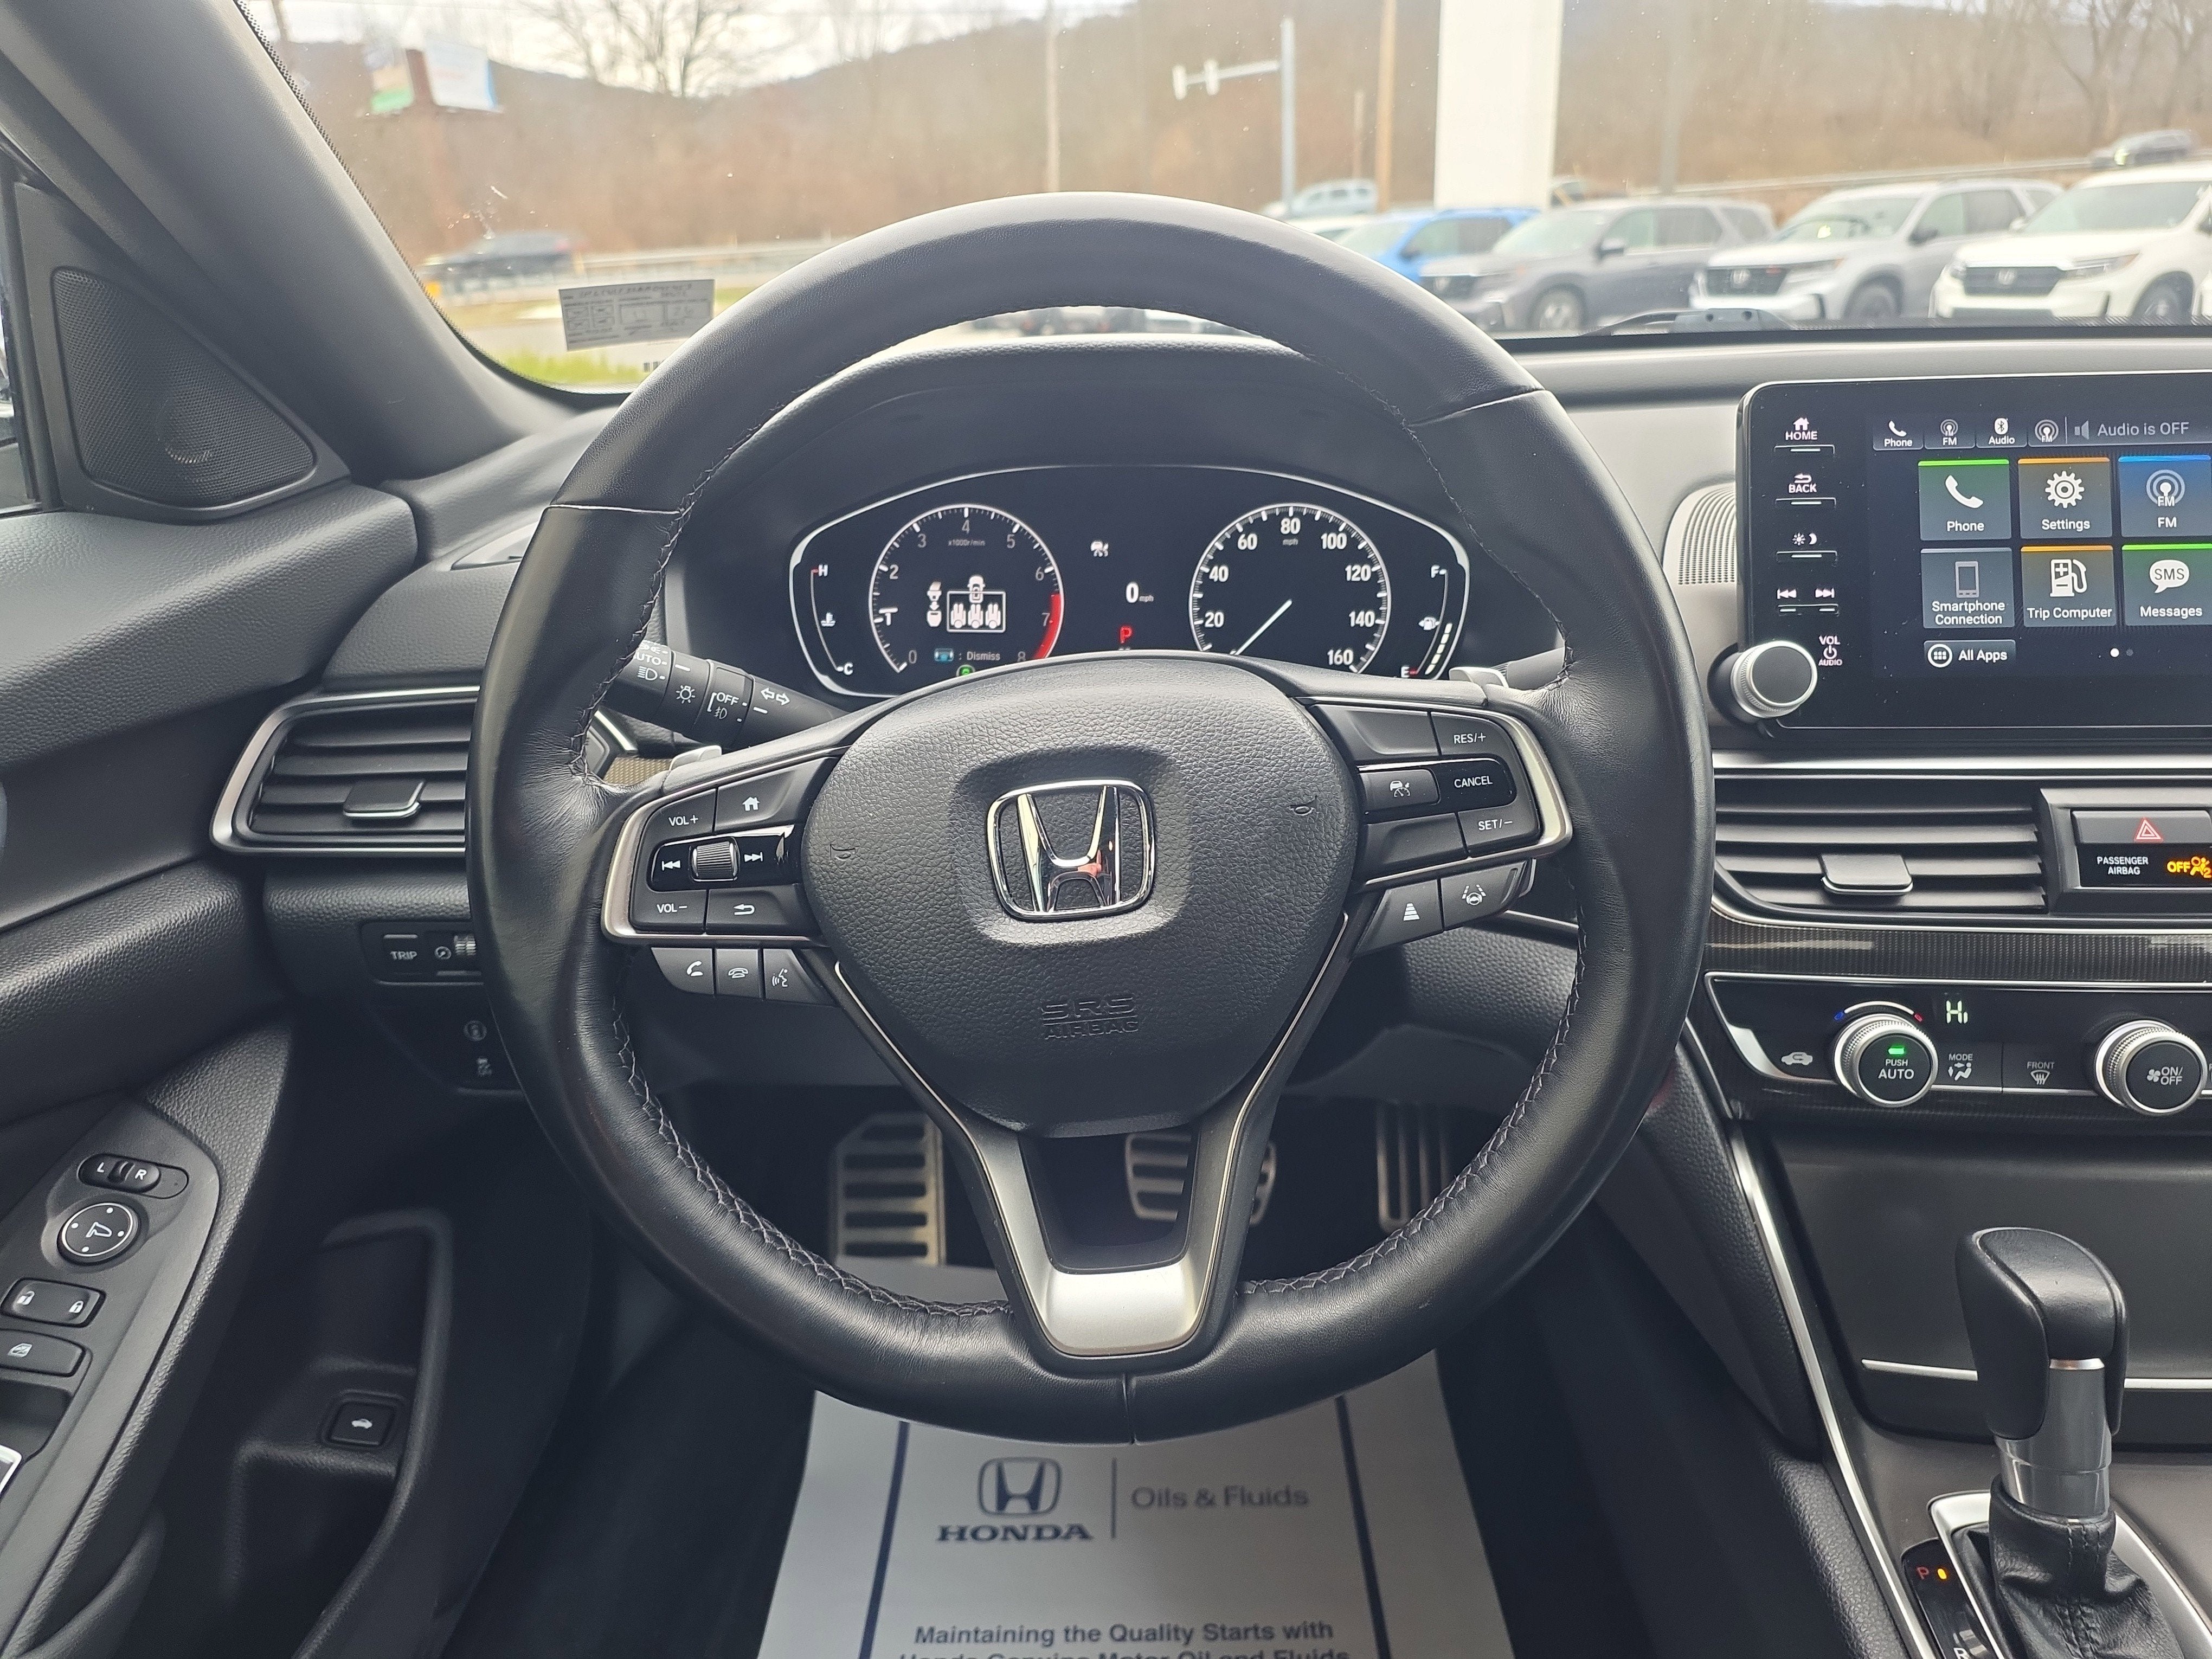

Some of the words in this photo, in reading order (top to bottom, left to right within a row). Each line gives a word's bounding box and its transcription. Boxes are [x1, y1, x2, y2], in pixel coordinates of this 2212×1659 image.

[2098, 423, 2139, 436] Audio
[2144, 424, 2155, 435] is
[2160, 422, 2189, 435] OFF
[1785, 431, 1817, 441] HOME
[1943, 437, 1957, 446] FM
[1989, 436, 2015, 445] Audio
[1884, 438, 1912, 448] Phone
[1789, 483, 1817, 493] BACK
[2158, 497, 2175, 507] FM
[962, 520, 970, 534] 4
[1281, 518, 1300, 535] 80
[1947, 520, 1984, 532] Phone
[2042, 519, 2091, 532] Settings
[2158, 517, 2177, 528] FM
[918, 533, 926, 548] 3
[1007, 534, 1015, 548] 5
[1238, 534, 1258, 550] 60
[1321, 533, 1347, 550] 100
[818, 565, 828, 576] H
[890, 565, 899, 580] 2
[1036, 567, 1044, 581] 6
[1209, 566, 1229, 582] 40
[1346, 565, 1371, 581] 120
[1431, 566, 1440, 577] F
[2154, 568, 2185, 581] SMS
[1126, 582, 1139, 603] 0
[1932, 601, 2005, 613] Smartphone
[2027, 608, 2050, 619] Trip
[2054, 607, 2112, 619] Computer
[2140, 606, 2203, 619] Messages
[1041, 613, 1050, 627] 7
[1205, 612, 1225, 627] 20
[1349, 611, 1375, 627] 140
[1935, 614, 2002, 625] Connection
[1120, 626, 1133, 644] P
[1819, 635, 1840, 645] VOL
[909, 650, 917, 664] 0
[967, 652, 1000, 661] Dismiss
[1328, 650, 1354, 666] 160
[1818, 658, 1843, 666] AUDIO
[1958, 650, 1975, 661] All
[1977, 650, 2008, 664] Apps
[844, 663, 853, 675] C
[1401, 666, 1410, 678] E
[716, 692, 739, 706] OFF
[1454, 732, 1486, 744] RES/+
[1454, 776, 1493, 788] CANCEL
[2097, 856, 2149, 865] PASSENGER
[2108, 866, 2140, 875] AIRBAG
[2166, 861, 2191, 873] OFF
[390, 951, 417, 960] TRIP
[1042, 996, 1134, 1019] SRS
[1044, 1020, 1139, 1040] AIRBAG
[2027, 1061, 2055, 1069] FRONT
[2161, 1066, 2183, 1076] ON/
[1878, 1069, 1914, 1079] AUTO
[2160, 1076, 2183, 1085] OFF
[97, 1162, 105, 1173] L
[135, 1169, 146, 1179] R
[1131, 1486, 1187, 1509] Oils
[1195, 1488, 1217, 1507] &
[1224, 1484, 1309, 1508] Fluids
[937, 1523, 1094, 1541] HONDA
[1916, 1566, 1929, 1580] P
[915, 1625, 1054, 1648] Maintaining
[1064, 1625, 1101, 1643] the
[1109, 1623, 1193, 1647] Quality
[1203, 1623, 1275, 1641] Starts
[1281, 1621, 1333, 1640] with
